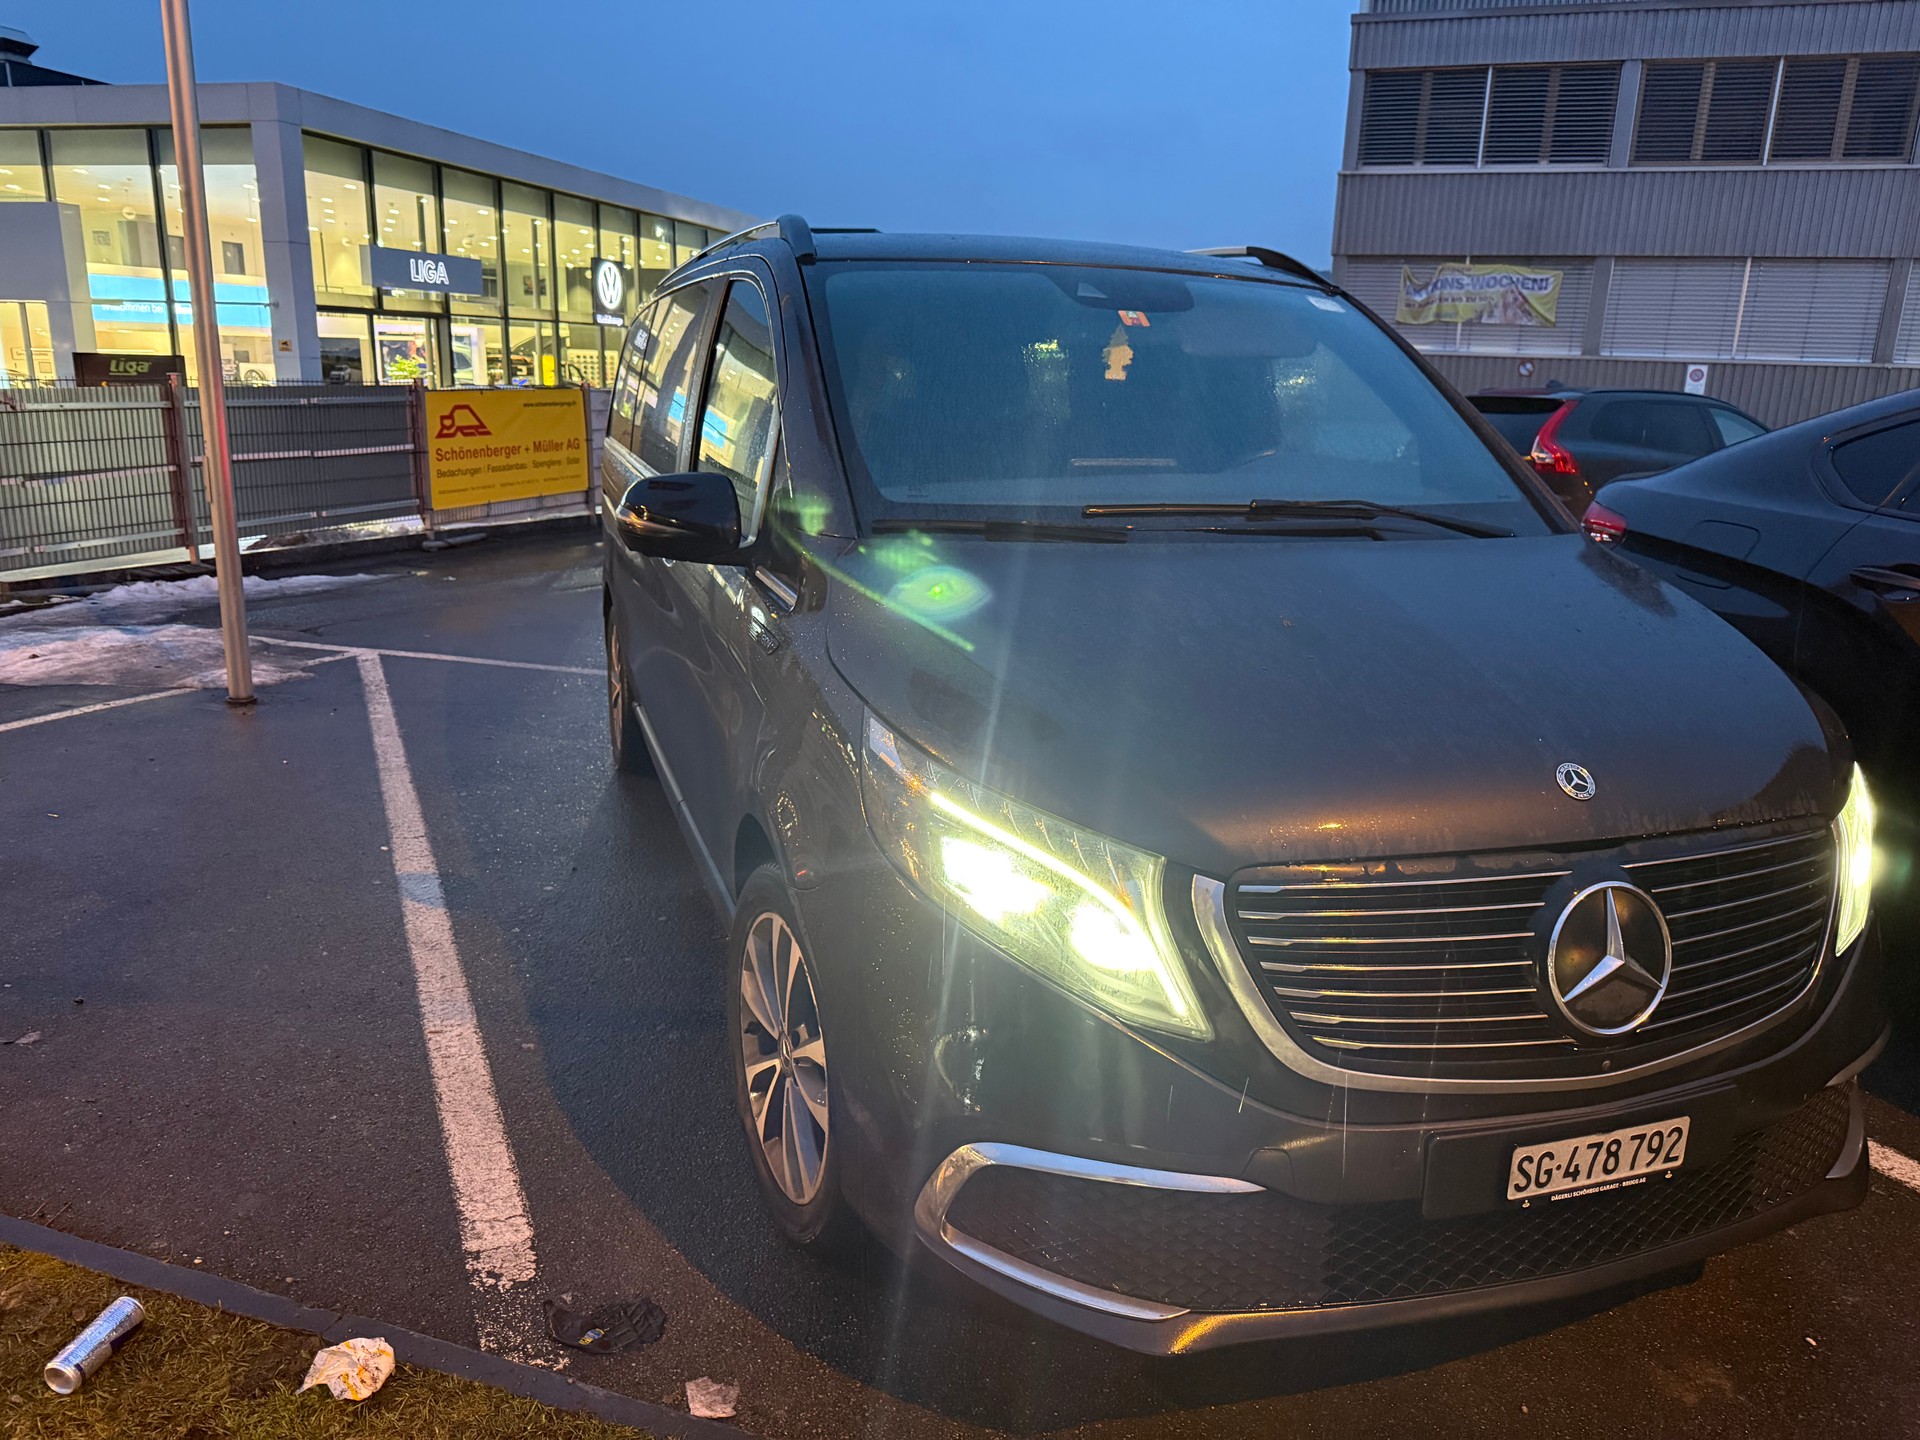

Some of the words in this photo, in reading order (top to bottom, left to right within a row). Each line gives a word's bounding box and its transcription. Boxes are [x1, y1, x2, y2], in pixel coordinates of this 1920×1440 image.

[409, 258, 450, 286] LIGA
[436, 445, 521, 462] Schönenberger
[524, 445, 531, 454] +
[533, 440, 564, 454] Müller
[566, 437, 580, 451] AG
[436, 466, 482, 479] Bedachungen
[487, 463, 527, 474] Fassadenbau
[1629, 1126, 1684, 1171] 792
[1600, 1182, 1620, 1192] GARAGE
